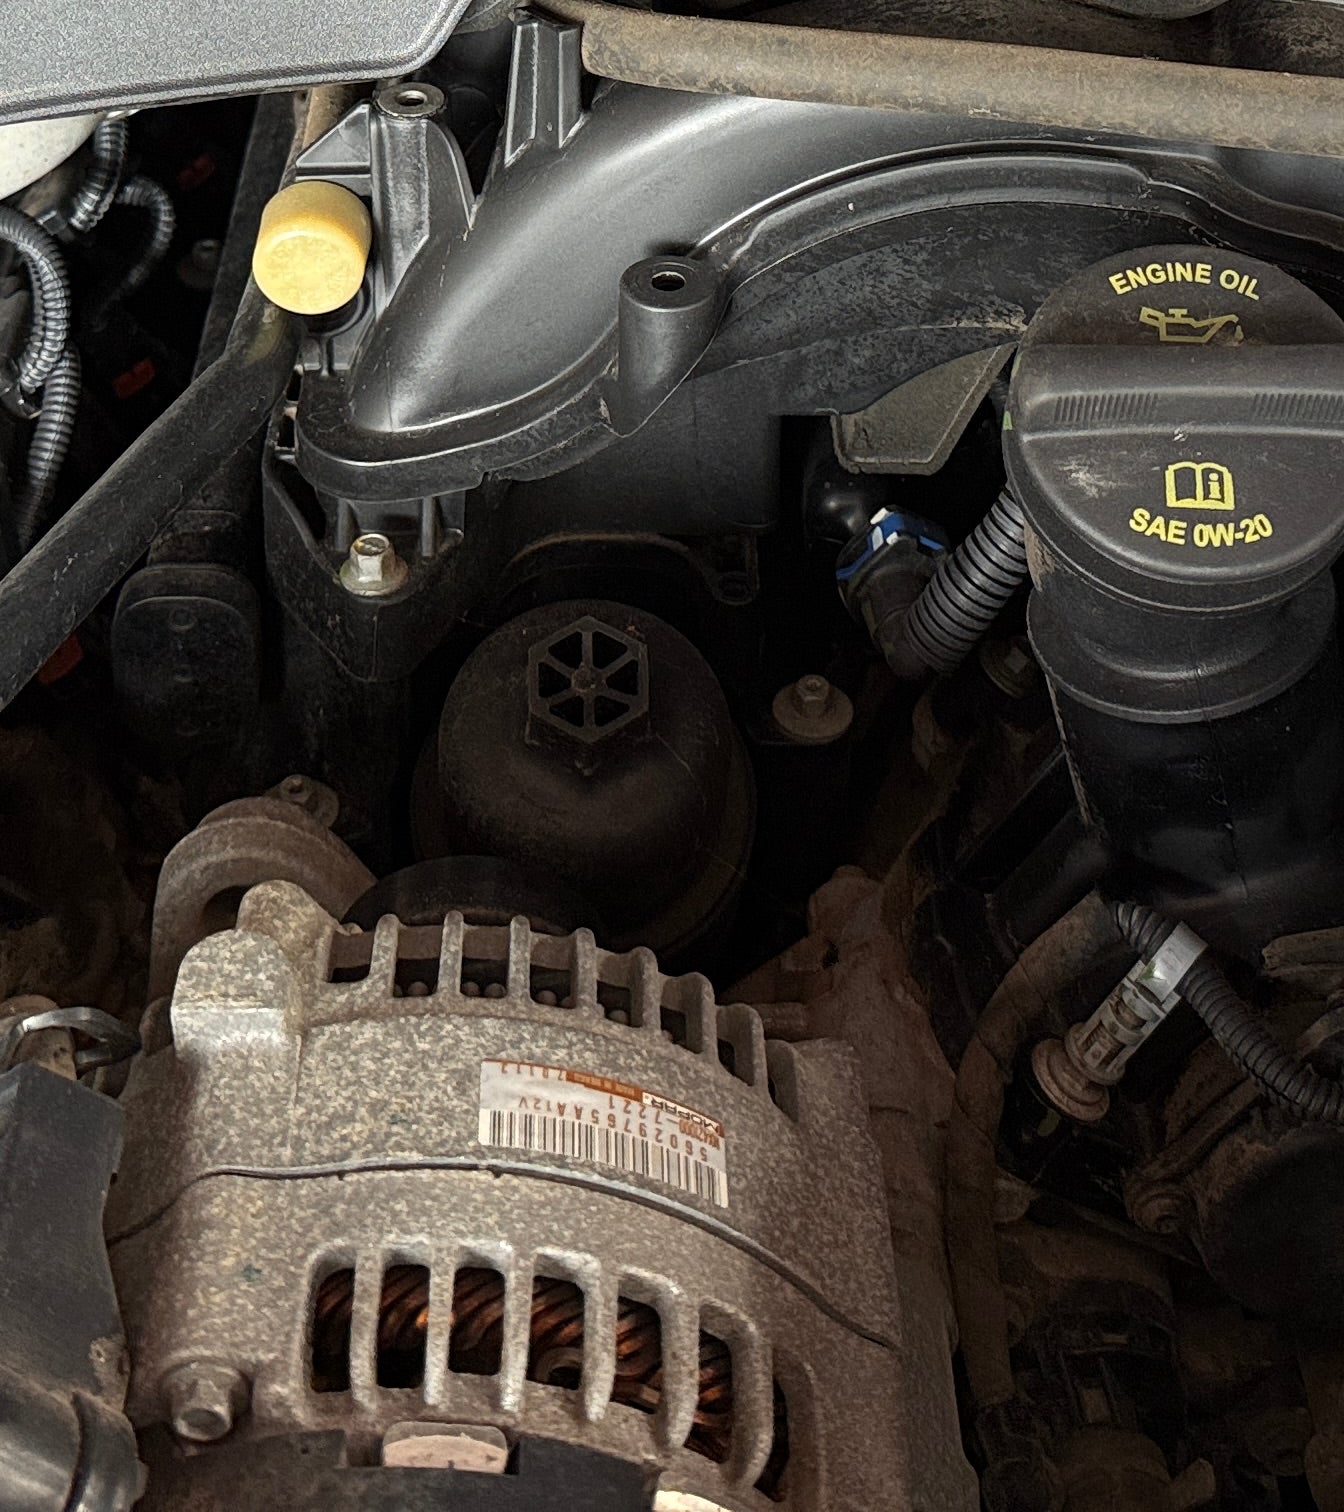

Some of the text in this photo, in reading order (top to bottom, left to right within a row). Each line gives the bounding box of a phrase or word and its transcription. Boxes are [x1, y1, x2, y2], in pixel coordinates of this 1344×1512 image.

[1108, 261, 1260, 301] ENGINE OIL
[1128, 507, 1274, 548] SAE 0W-20
